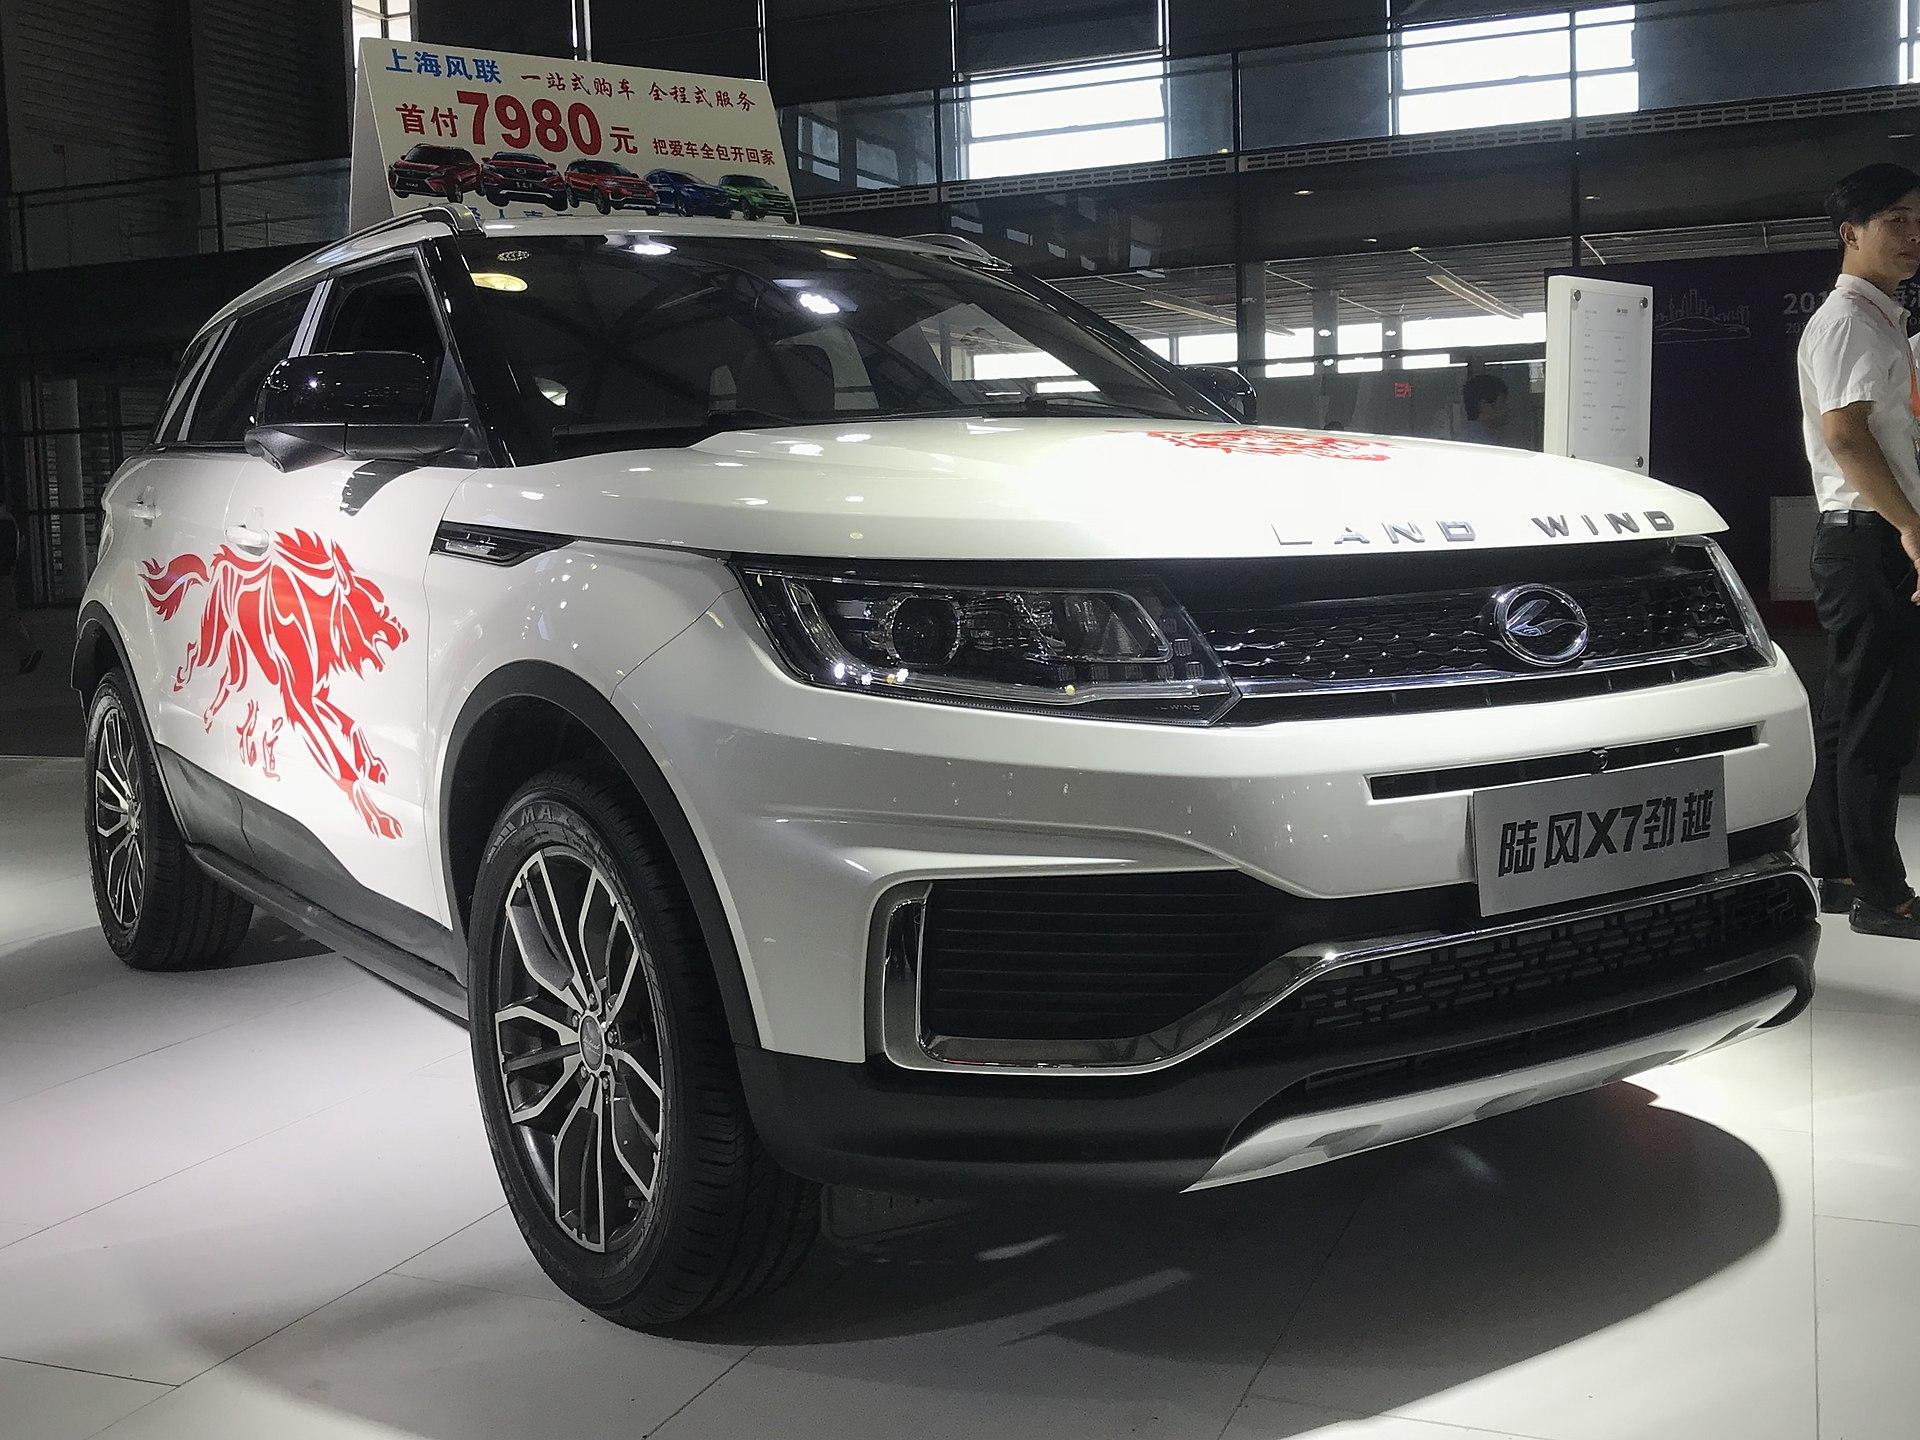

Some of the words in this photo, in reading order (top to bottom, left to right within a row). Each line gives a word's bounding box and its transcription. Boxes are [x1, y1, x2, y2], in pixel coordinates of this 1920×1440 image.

[386, 48, 503, 84] 上海风联
[520, 71, 635, 100] 一站式购车
[648, 82, 756, 112] 全程式服务
[652, 138, 776, 166] 把爱车全包开回家
[1270, 520, 1476, 546] LAND
[1531, 510, 1675, 538] WIND
[1497, 789, 1714, 878] 陆风X7劲越
